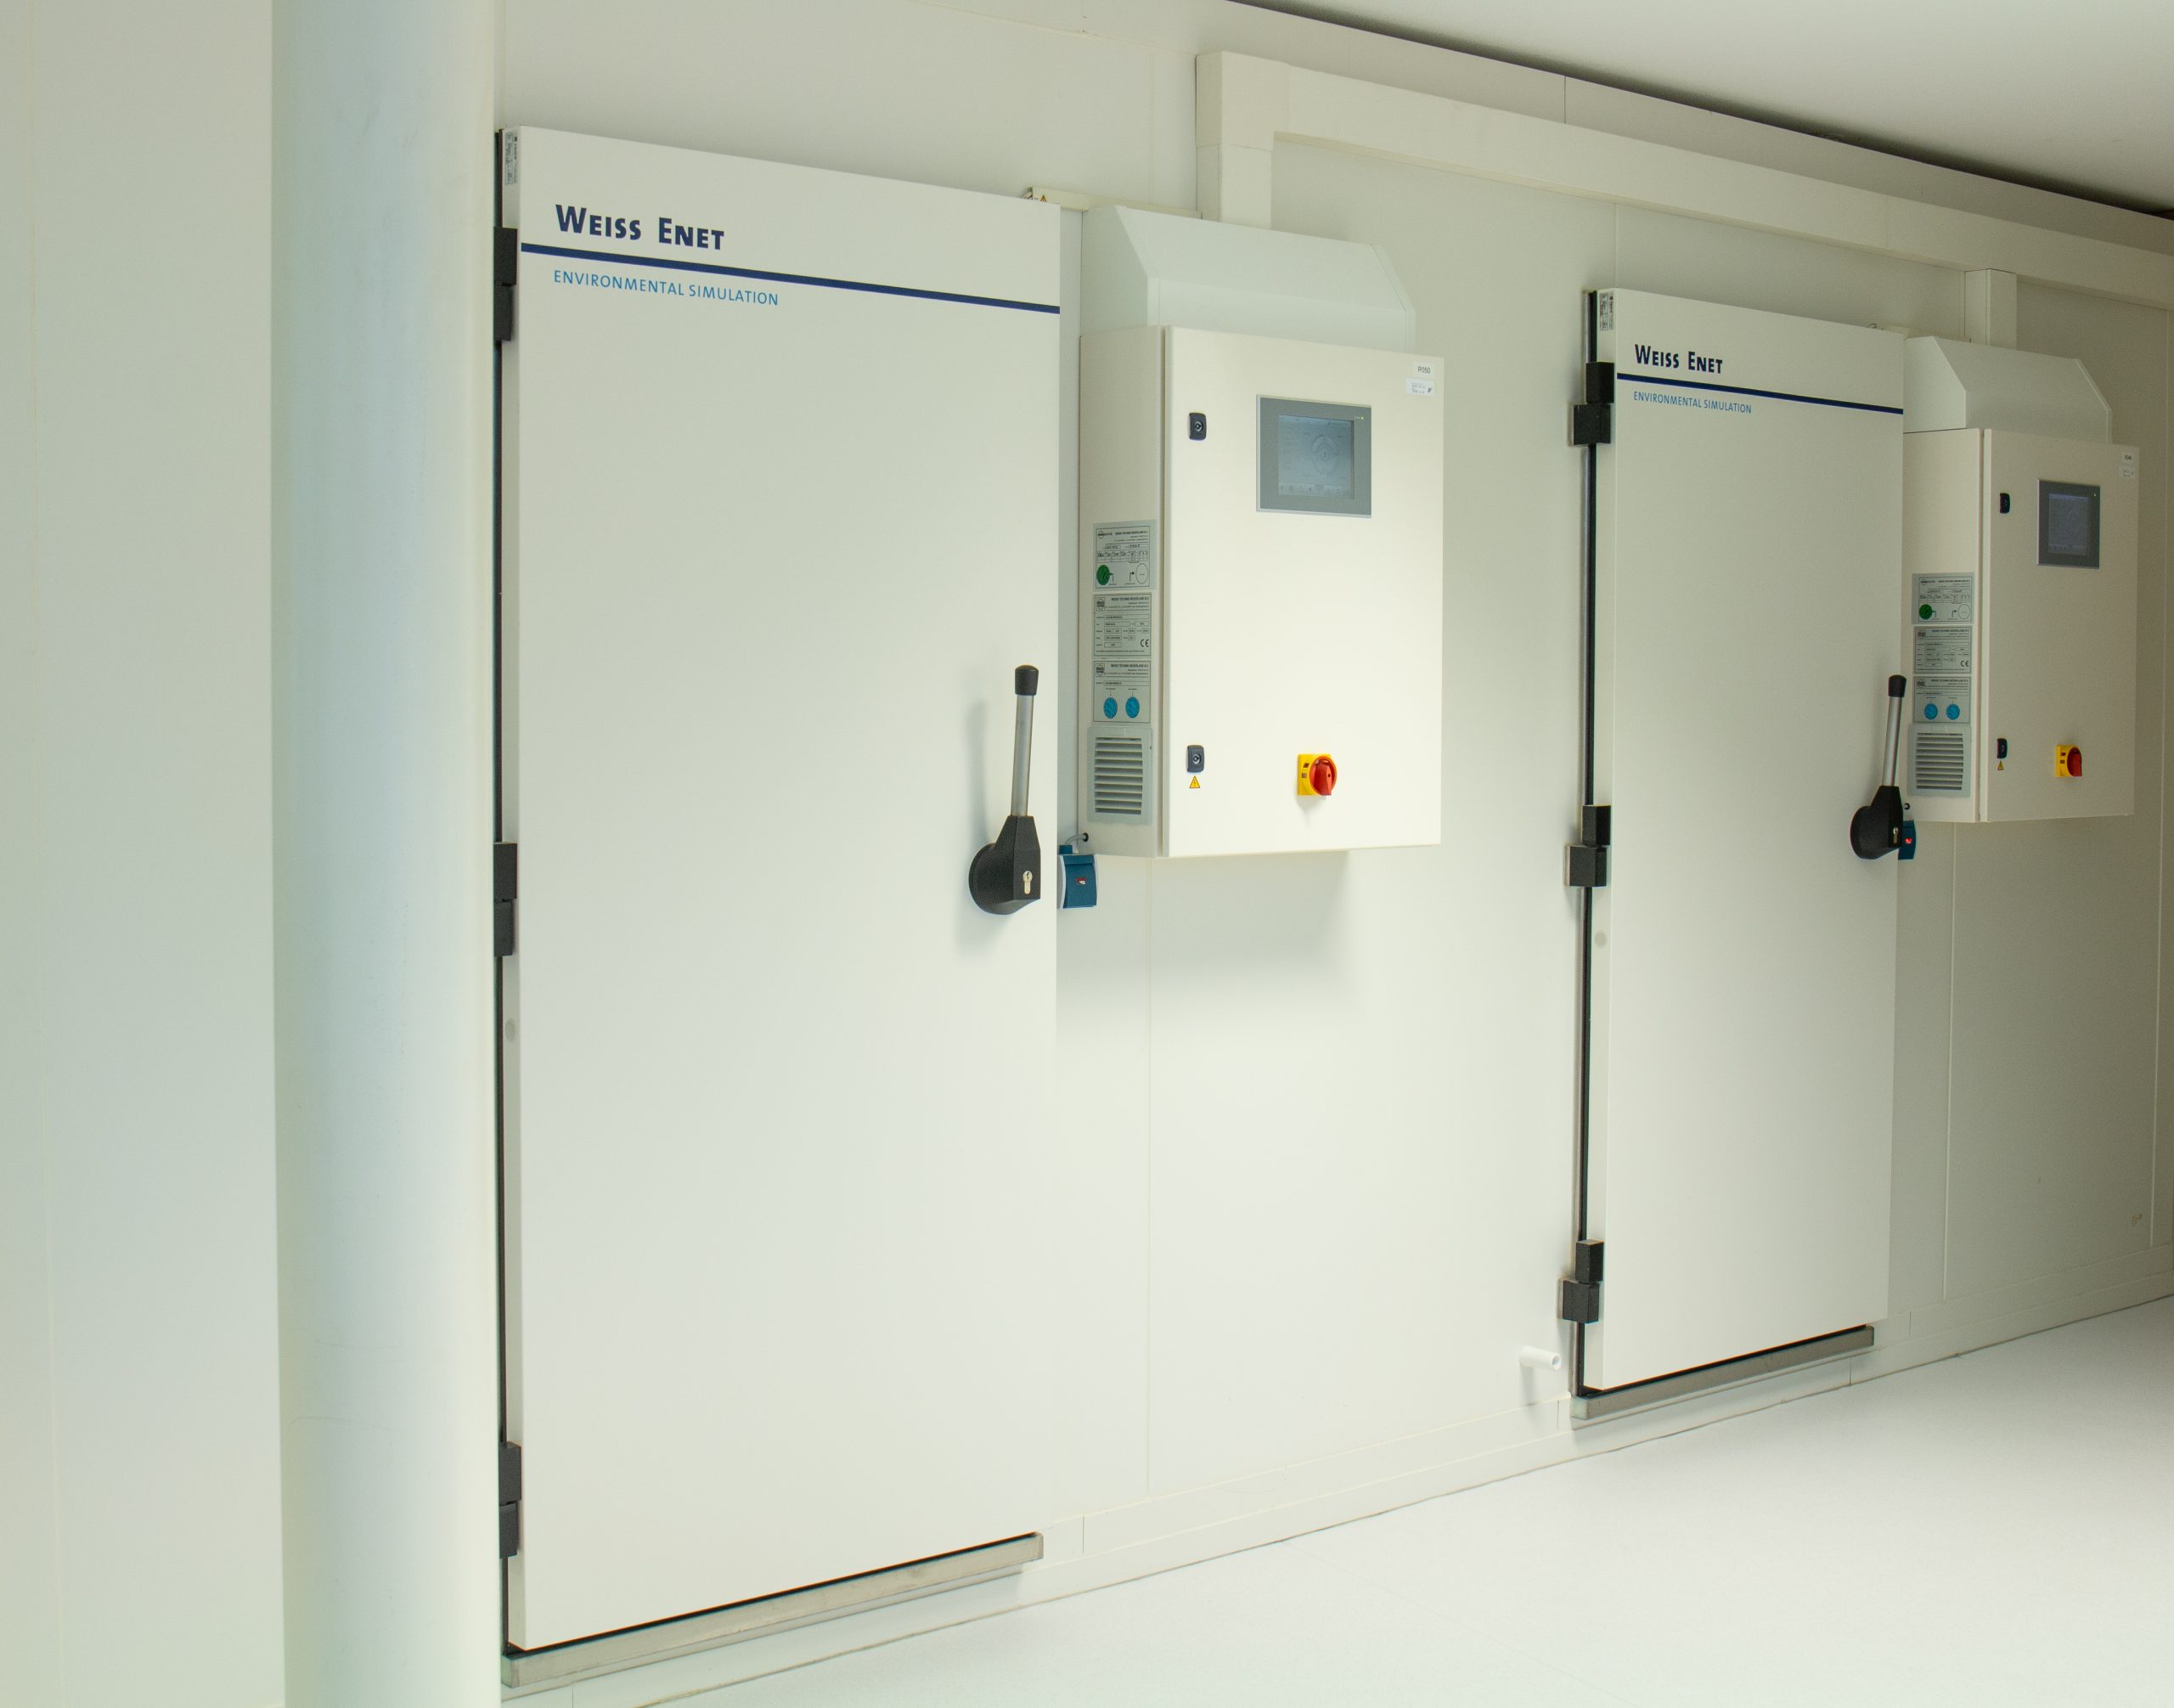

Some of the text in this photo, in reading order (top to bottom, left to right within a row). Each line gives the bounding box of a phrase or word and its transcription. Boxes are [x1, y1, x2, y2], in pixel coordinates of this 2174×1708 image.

[554, 269, 778, 307] ENVIRONMENTAL SIMULATION
[1633, 390, 1752, 414] ENVIRONMENTAL SIMULATION
